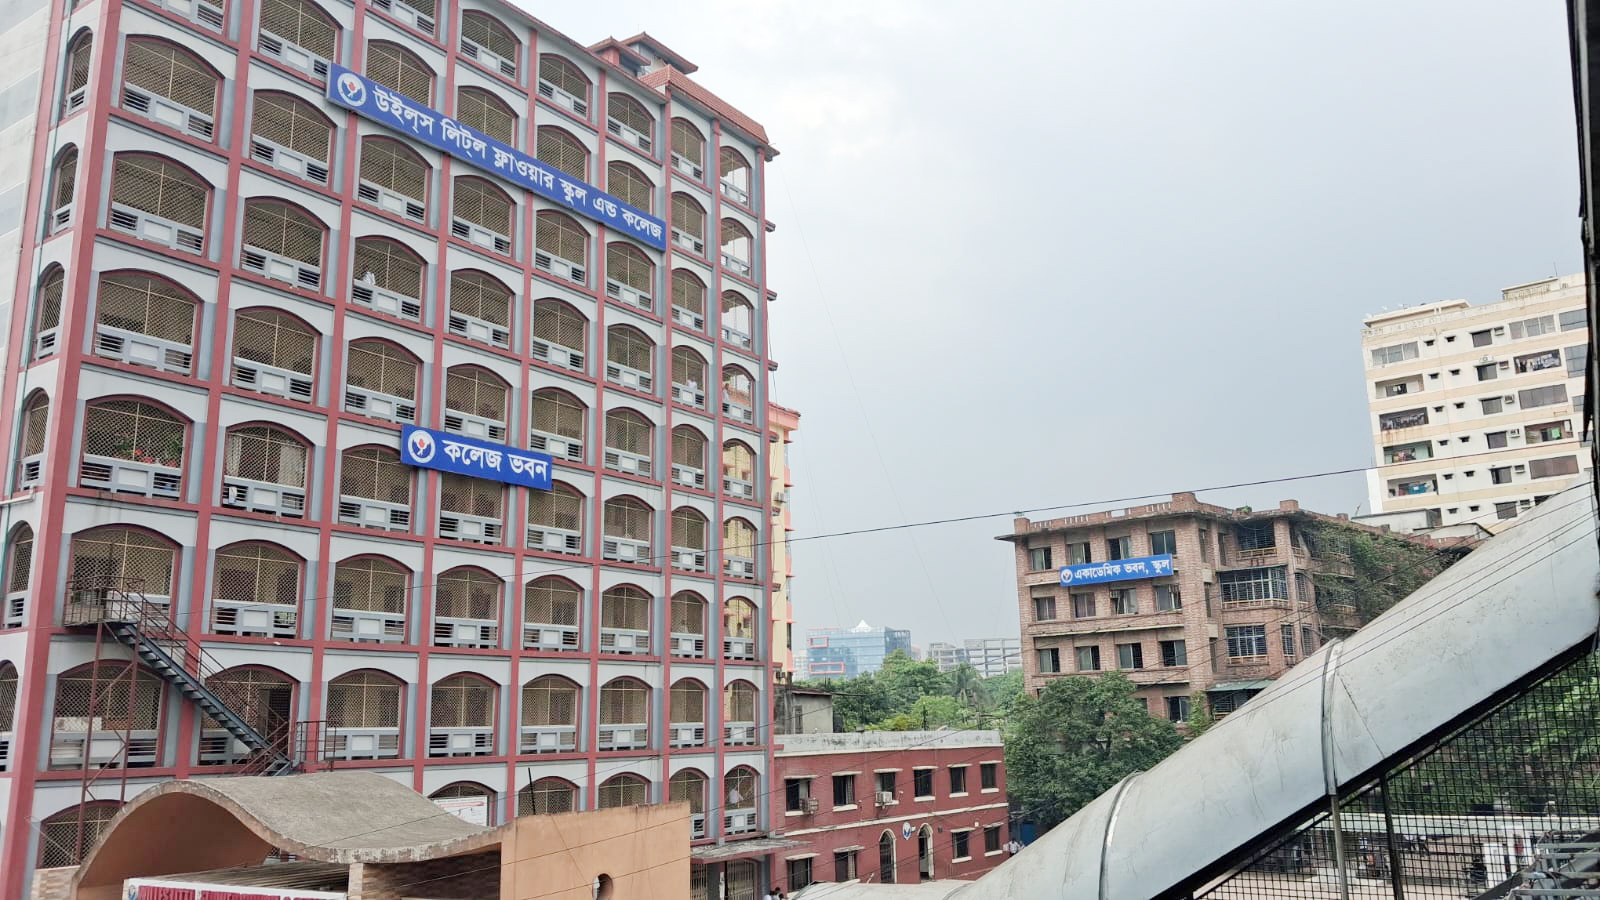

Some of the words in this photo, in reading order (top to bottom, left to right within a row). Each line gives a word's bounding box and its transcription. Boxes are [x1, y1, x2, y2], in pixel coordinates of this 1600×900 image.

[492, 146, 555, 190] ফ্লাওয়ার
[558, 178, 588, 207] স্কুল
[621, 208, 662, 240] কলেজ
[442, 440, 503, 472] কলেজ
[507, 454, 549, 481] ভবন
[1074, 563, 1121, 579] একাডেমিক
[1151, 559, 1170, 574] স্কুল
